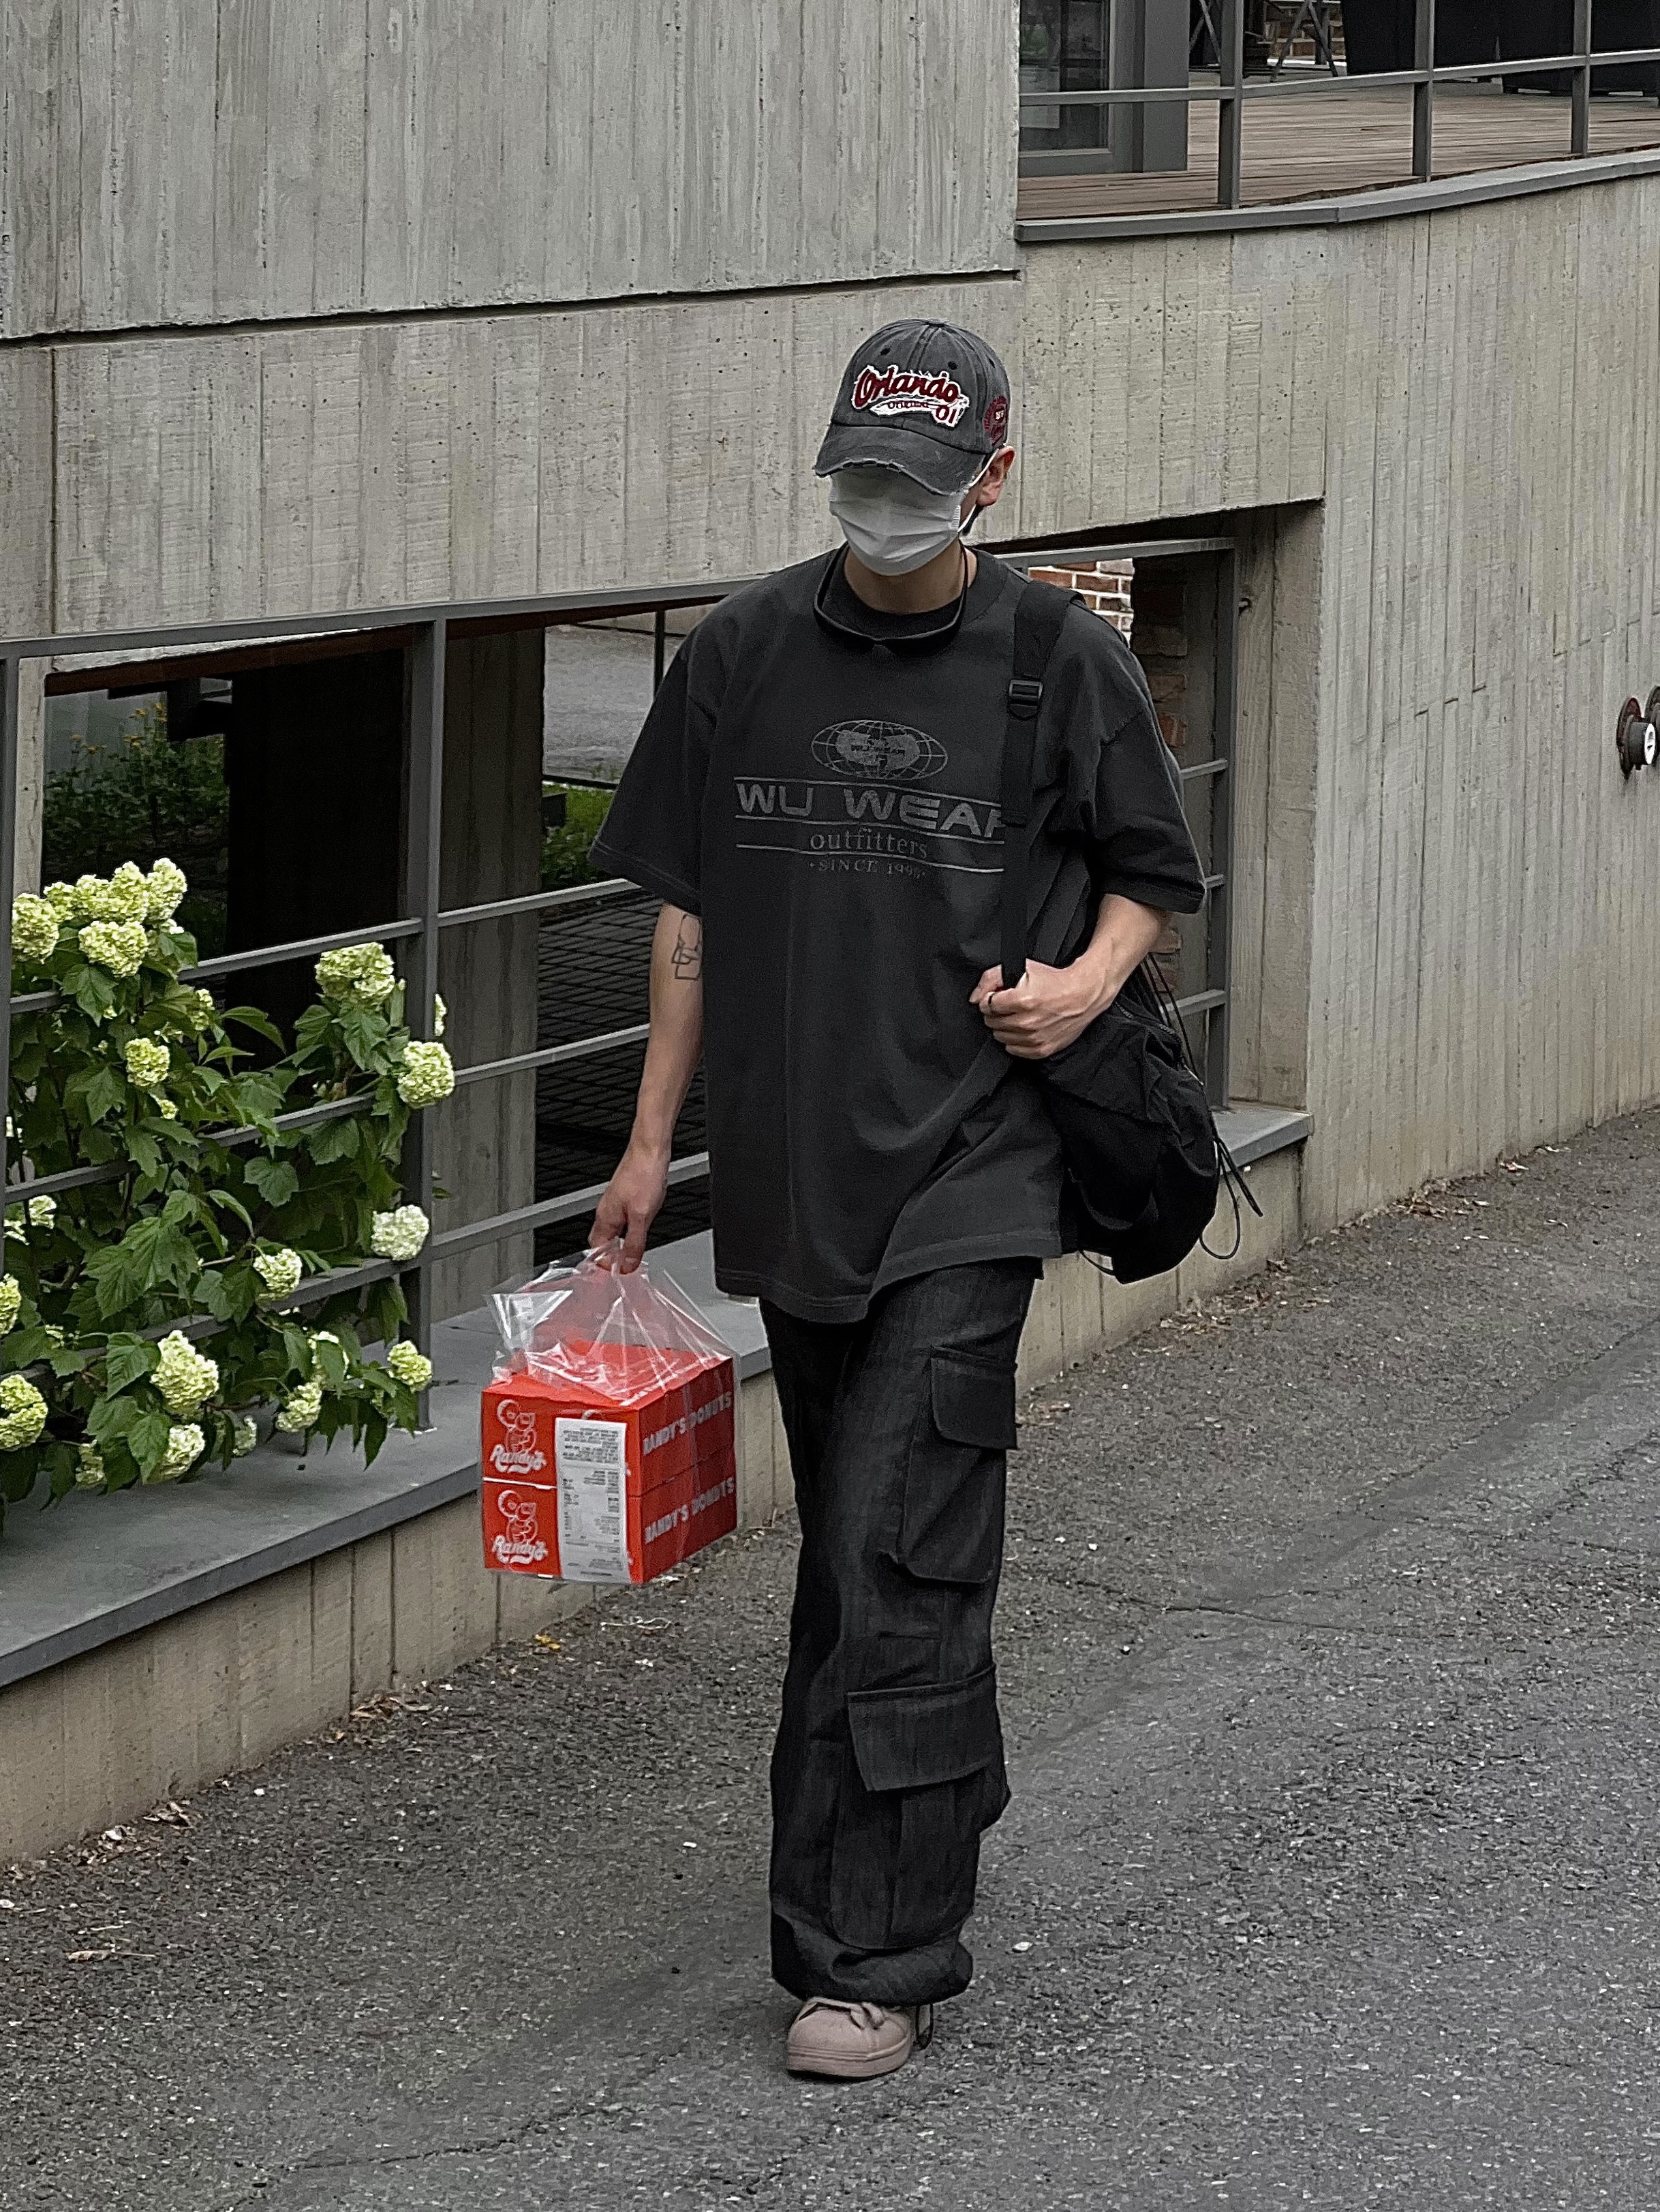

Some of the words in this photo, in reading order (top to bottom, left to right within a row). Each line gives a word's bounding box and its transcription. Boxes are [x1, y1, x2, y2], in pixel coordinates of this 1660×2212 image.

[853, 367, 960, 408] Orlando
[737, 783, 814, 817] WU
[810, 827, 927, 858] outfitters
[818, 859, 878, 873] SINCE
